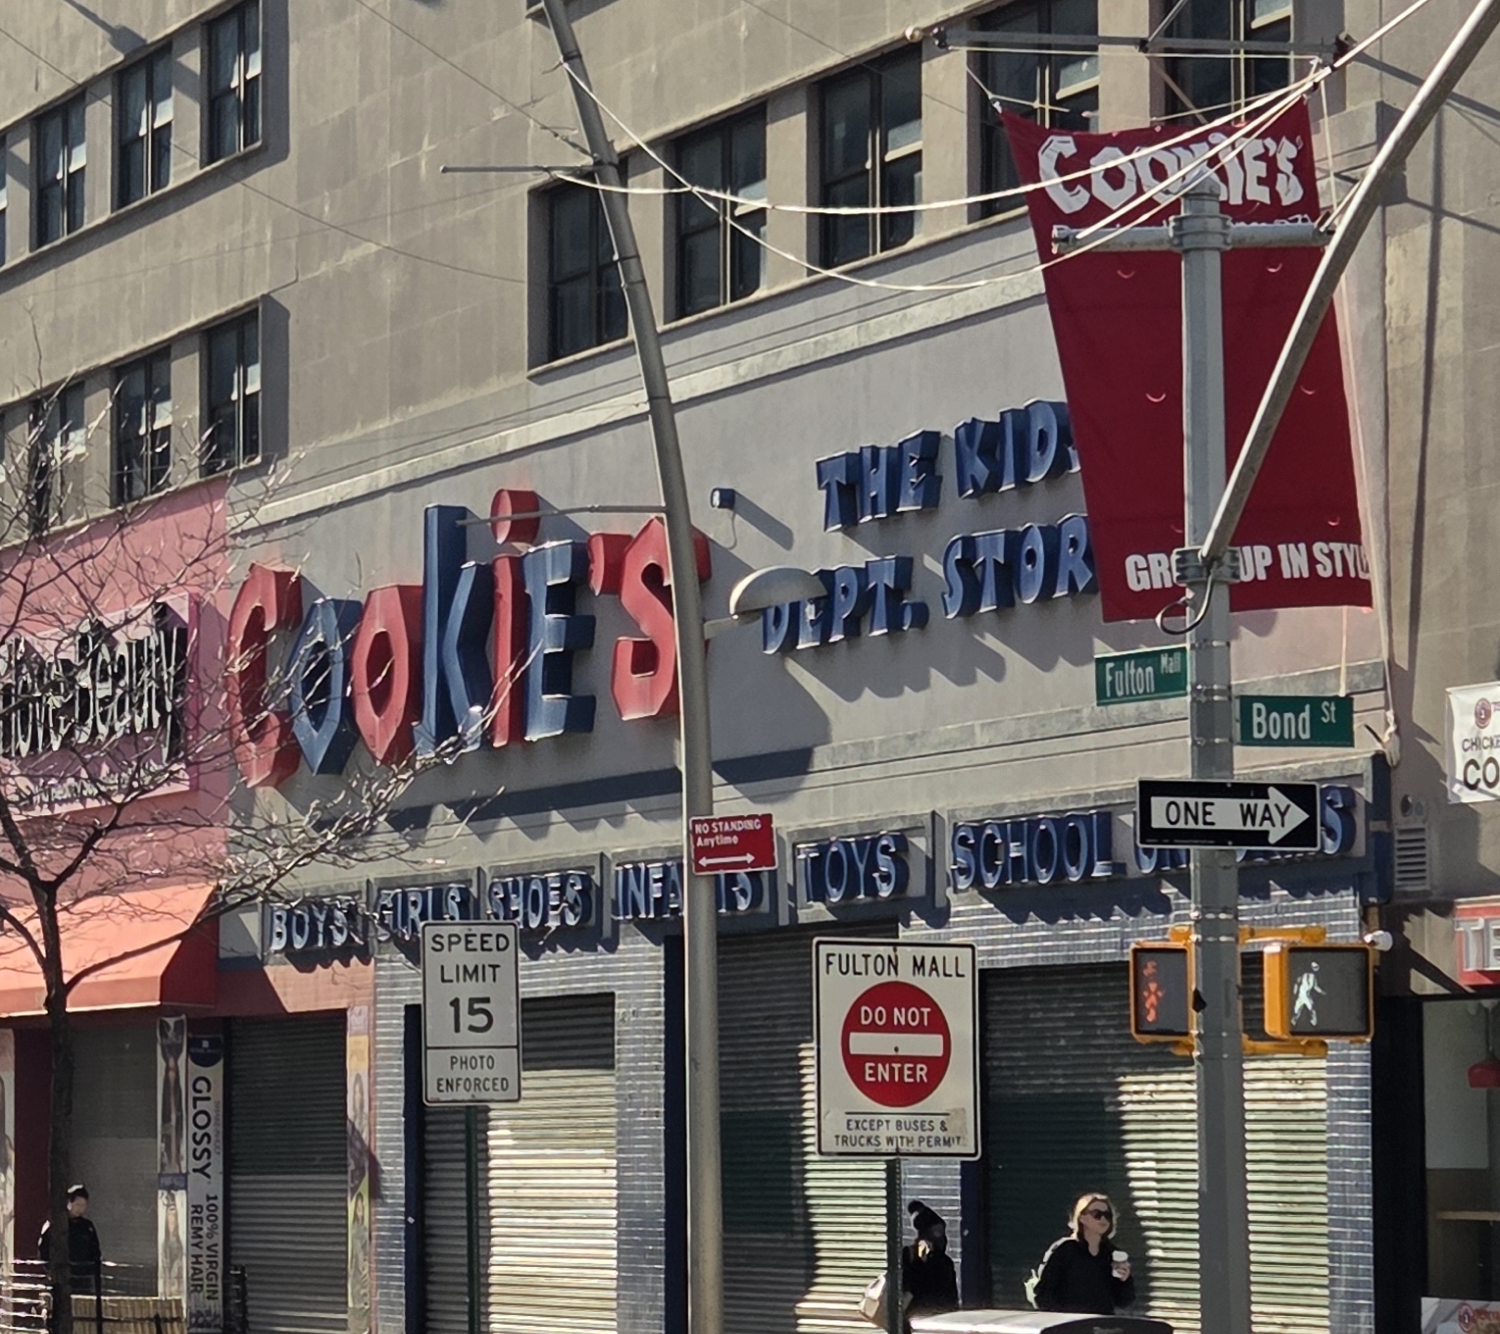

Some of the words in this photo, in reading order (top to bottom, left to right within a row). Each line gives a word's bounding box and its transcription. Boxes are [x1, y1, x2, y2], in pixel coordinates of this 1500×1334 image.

[816, 429, 941, 533] THE
[954, 398, 1081, 499] KID
[1239, 545, 1273, 583] UP
[1277, 542, 1310, 580] IN
[1105, 662, 1156, 698] Fulton
[1160, 652, 1182, 675] Mall
[1251, 702, 1312, 741] Bond
[1320, 701, 1338, 725] St
[1463, 756, 1500, 791] CO
[694, 822, 710, 835] NO
[710, 817, 762, 834] STANDING
[1165, 800, 1217, 827] ONE
[1239, 802, 1292, 829] WAY
[696, 834, 739, 849] Anytime
[950, 810, 1112, 894] SCHOOL
[797, 830, 902, 904] TOYS
[486, 870, 592, 930] SHOES
[614, 861, 756, 921] INFAS
[269, 897, 352, 952] BOYS
[430, 932, 511, 953] SPEED
[439, 963, 501, 984] LIMIT
[826, 952, 899, 977] FULTON
[912, 954, 966, 978] MALL
[448, 996, 495, 1035] 15
[859, 1005, 887, 1026] DO
[892, 1006, 932, 1027] NOT
[449, 1054, 496, 1072] PHOTO
[864, 1062, 929, 1083] ENTER
[435, 1075, 510, 1094] ENFORCED
[191, 1075, 212, 1181] GLOSSY
[834, 1134, 882, 1147] TRUCKS
[885, 1135, 915, 1148] WITH
[918, 1135, 962, 1149] PERMIT
[845, 1119, 891, 1132] EXCEPT
[895, 1119, 936, 1132] BUSES
[939, 1119, 949, 1133] &
[190, 1203, 205, 1249] REMY
[205, 1193, 219, 1240] 100%
[190, 1251, 205, 1295] HAIR
[204, 1242, 219, 1302] VIRGIN
